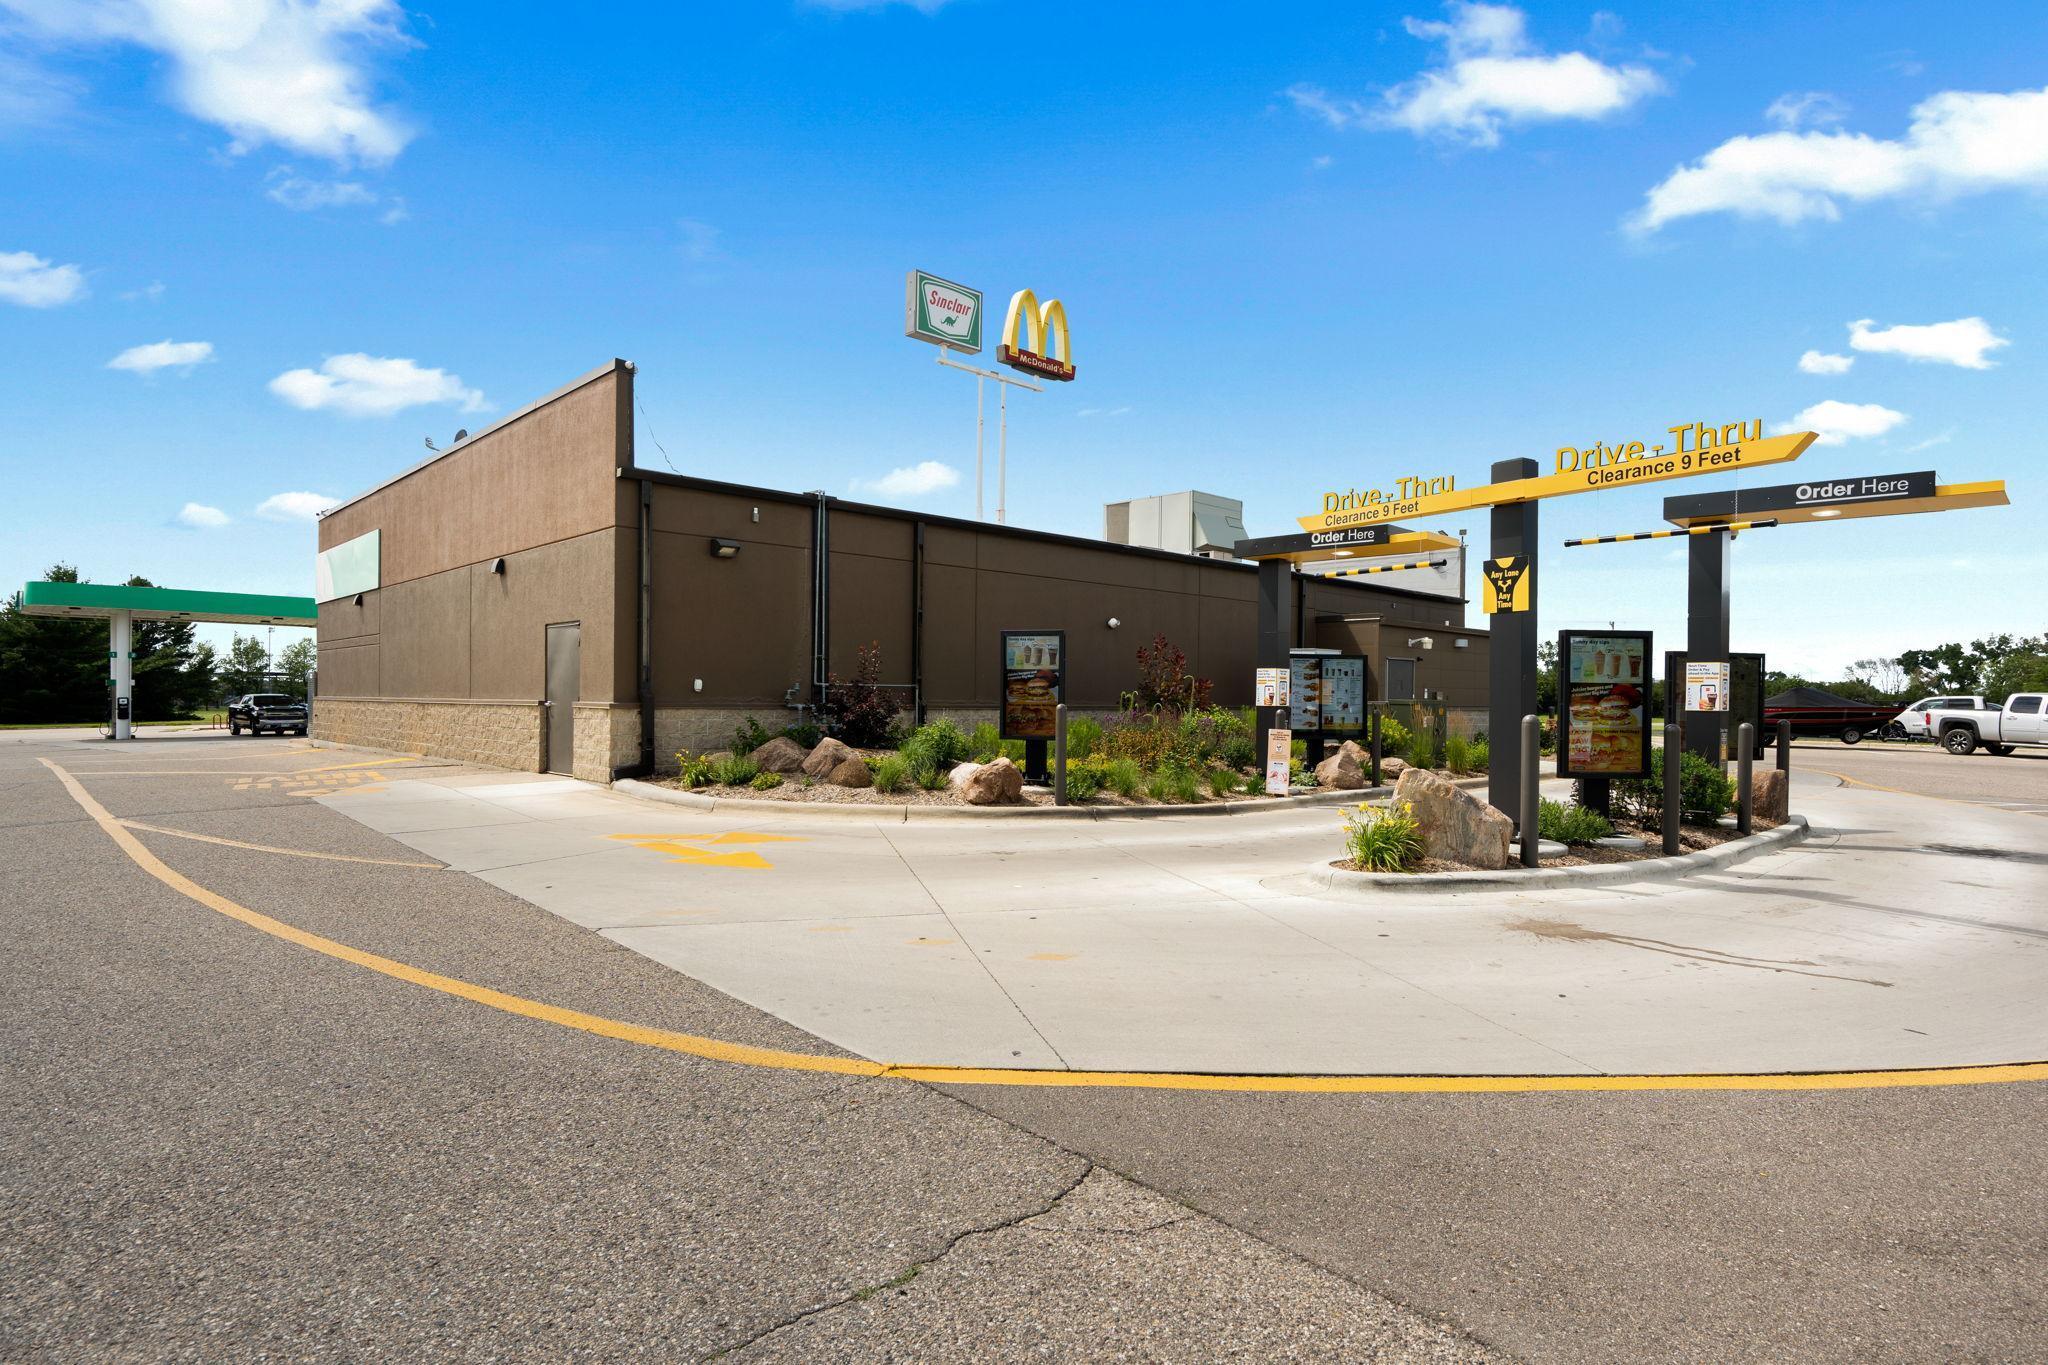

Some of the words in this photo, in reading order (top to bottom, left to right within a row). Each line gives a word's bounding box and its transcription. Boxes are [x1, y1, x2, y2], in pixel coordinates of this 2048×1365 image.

[929, 290, 972, 316] Sinclair
[1019, 354, 1064, 374] McDonald's
[1555, 440, 1645, 475] Drive
[1667, 418, 1762, 454] Thru
[1587, 461, 1675, 486] Clearance
[1681, 455, 1692, 470] 9
[1698, 446, 1742, 468] Feet
[1322, 488, 1381, 514] Drive
[1395, 475, 1455, 500] Thru
[1795, 483, 1855, 501] Order
[1862, 478, 1909, 494] Here
[1325, 508, 1379, 527] Clearance
[1382, 504, 1390, 517] 9
[1393, 501, 1419, 514] Feet
[1311, 530, 1345, 544] Order
[1347, 529, 1375, 541] Here
[1490, 570, 1503, 580] Any
[1497, 600, 1512, 608] Time
[1498, 592, 1511, 601] Any
